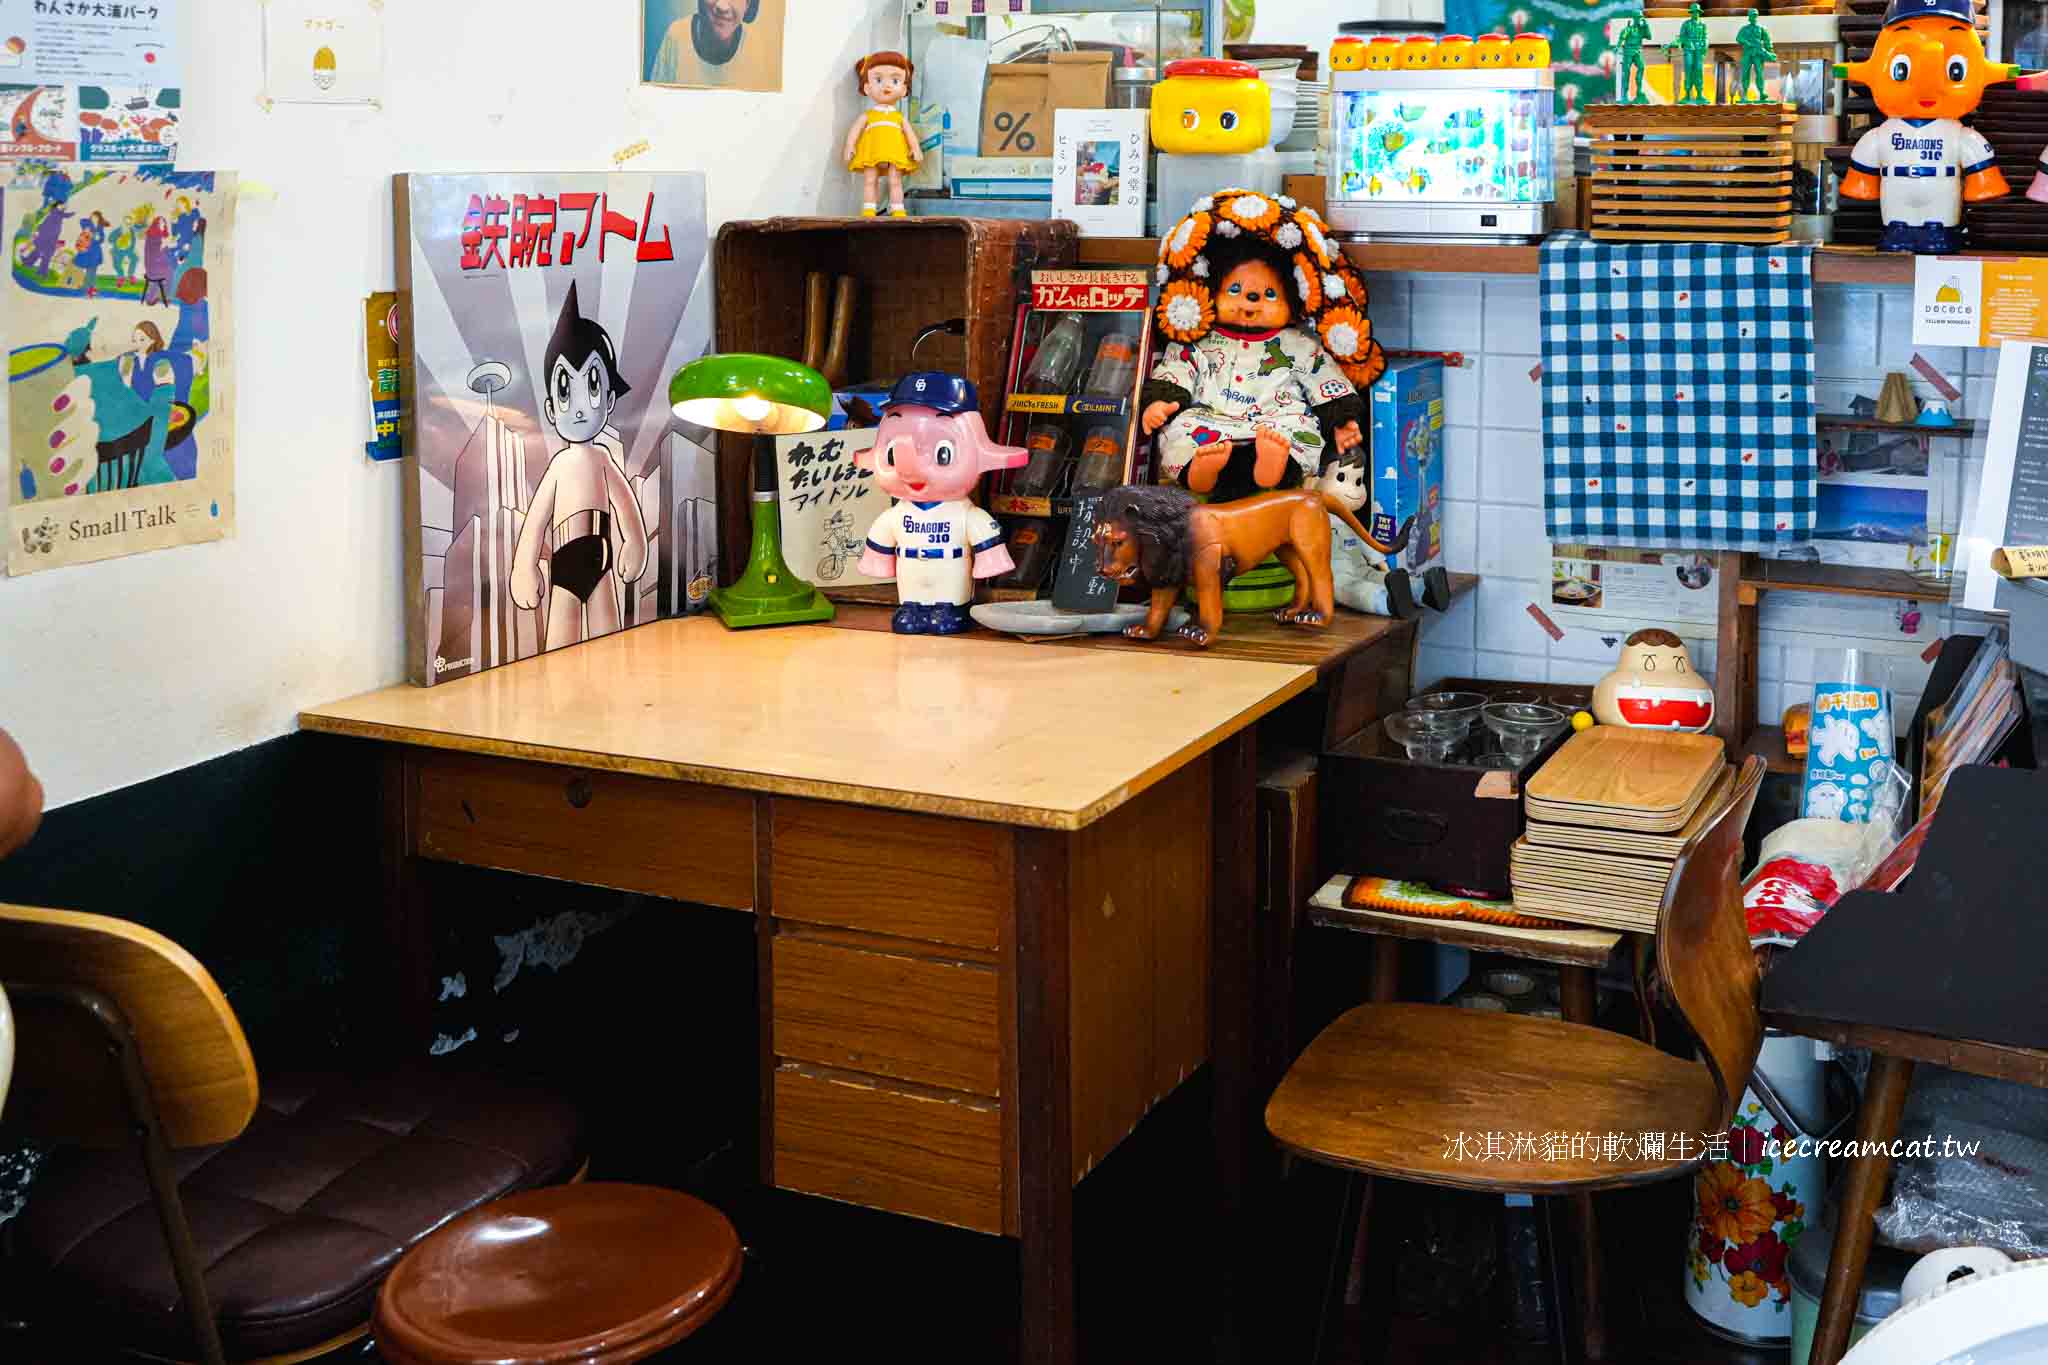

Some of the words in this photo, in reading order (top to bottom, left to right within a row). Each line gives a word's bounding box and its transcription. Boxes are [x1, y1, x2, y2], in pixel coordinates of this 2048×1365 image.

[461, 192, 674, 270] 鉄腕アトム
[1035, 286, 1144, 307] ガムはロッテ
[788, 484, 869, 511] アイドル
[69, 512, 127, 541] Small
[131, 505, 176, 529] Talk
[928, 534, 950, 543] 310
